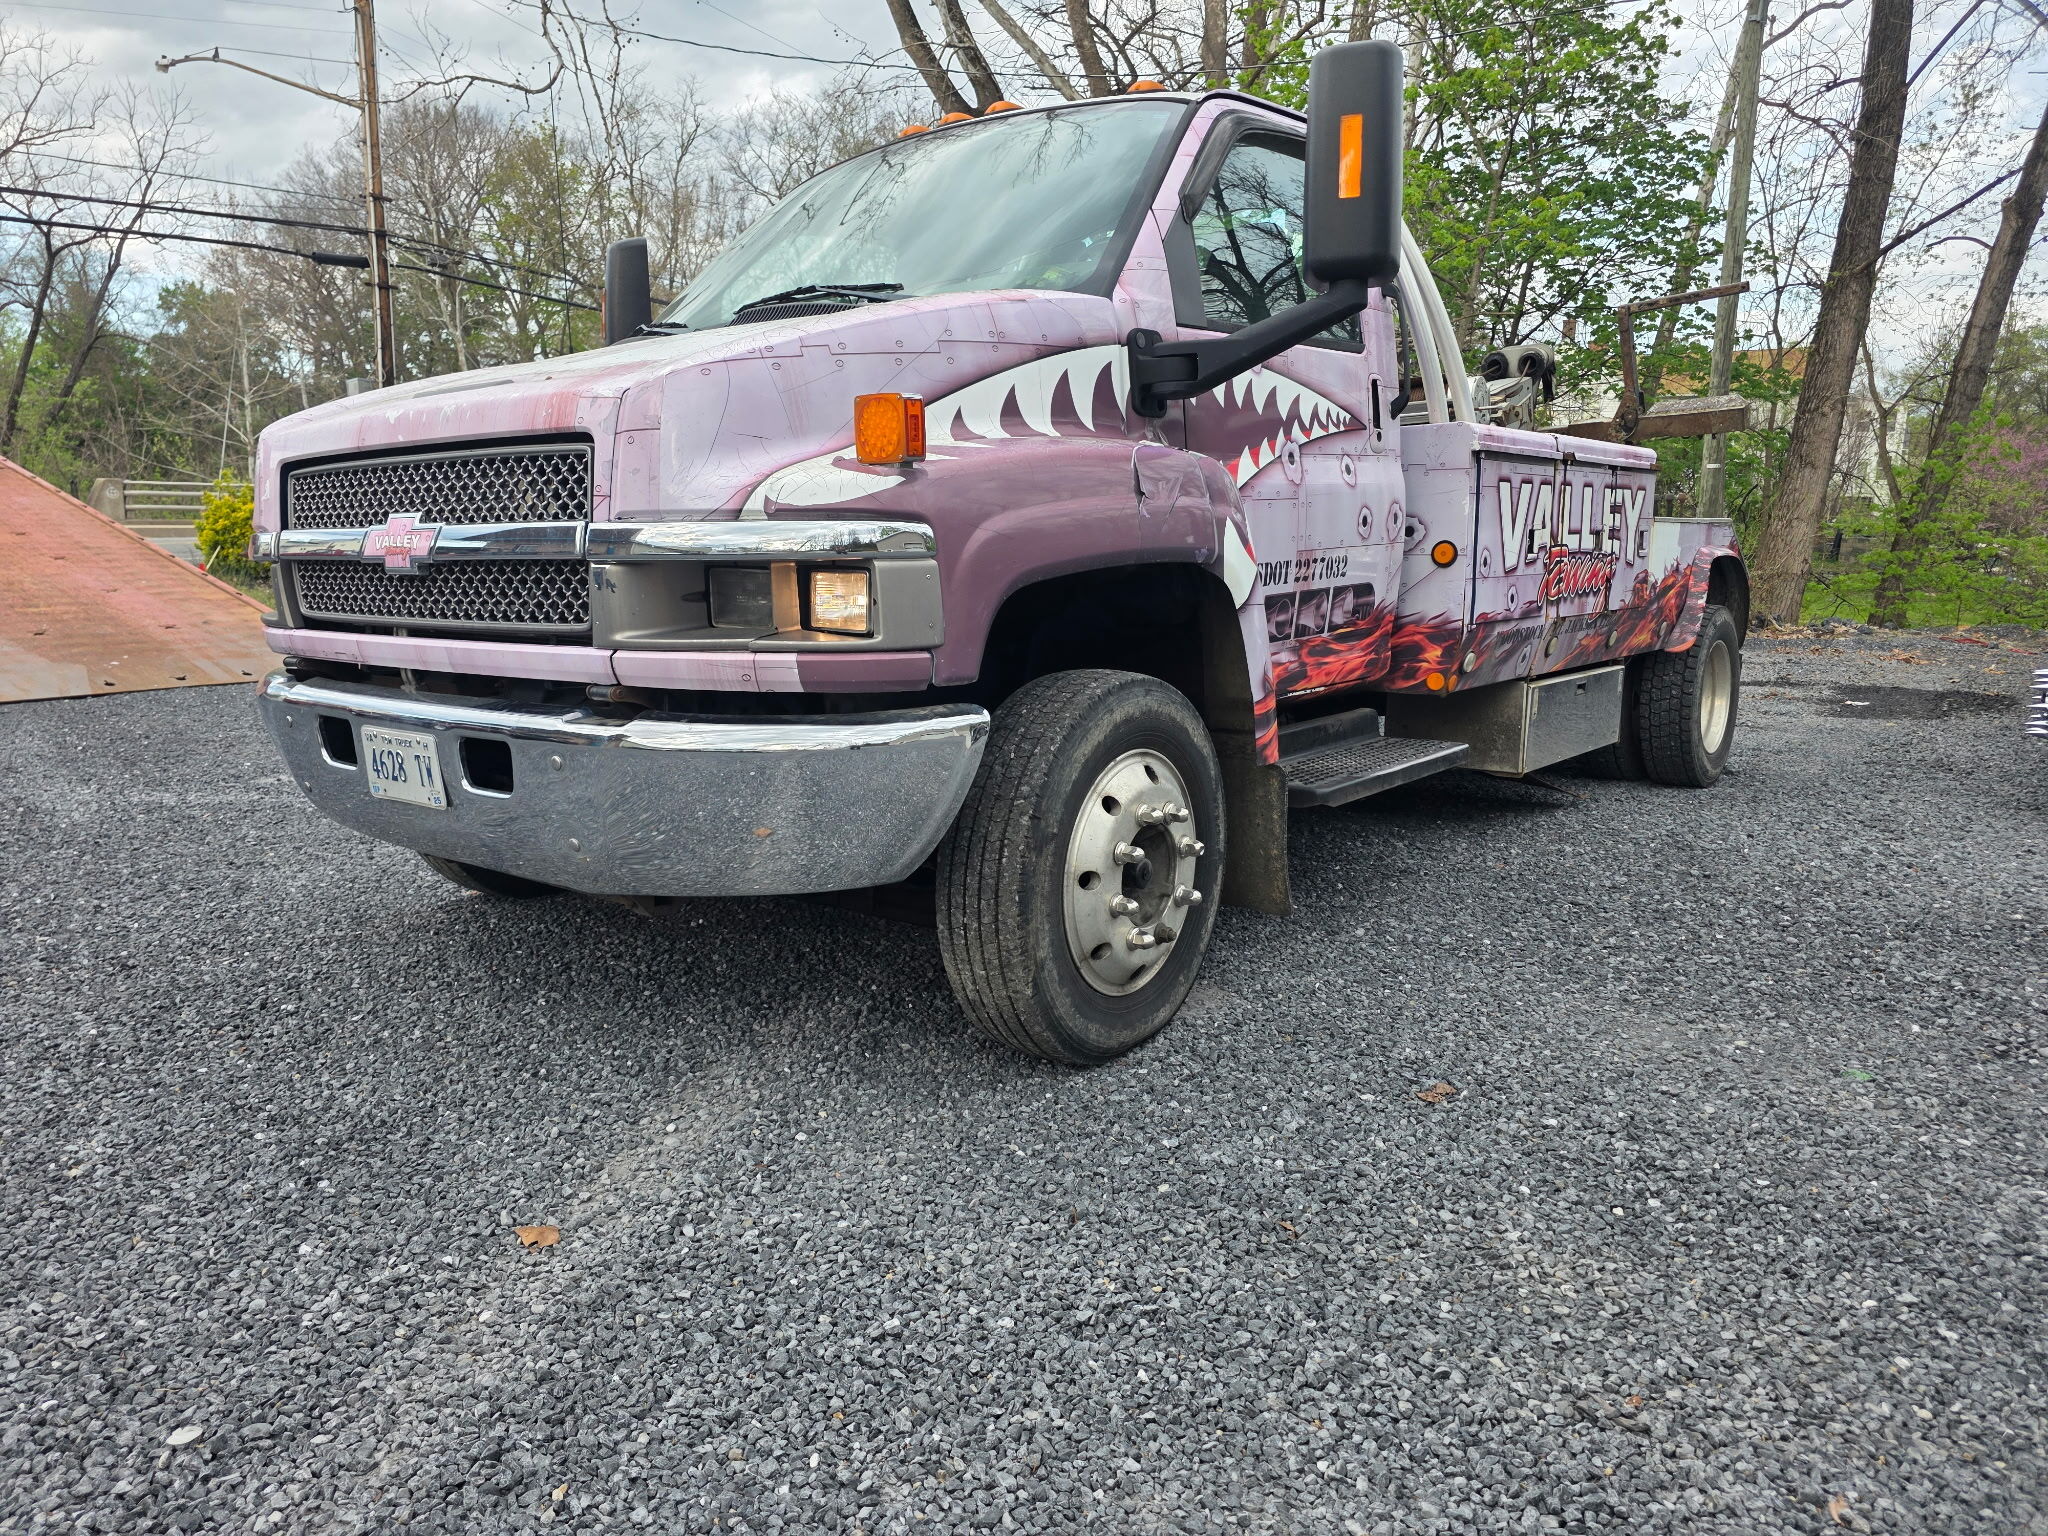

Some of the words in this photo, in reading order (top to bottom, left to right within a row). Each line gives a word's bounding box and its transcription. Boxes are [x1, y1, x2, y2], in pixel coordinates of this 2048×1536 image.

[375, 534, 420, 550] VALLEY
[1499, 480, 1647, 573] VALLEY
[1257, 560, 1292, 586] SDOT
[1294, 555, 1349, 583] 2277032
[373, 746, 407, 783] 4628
